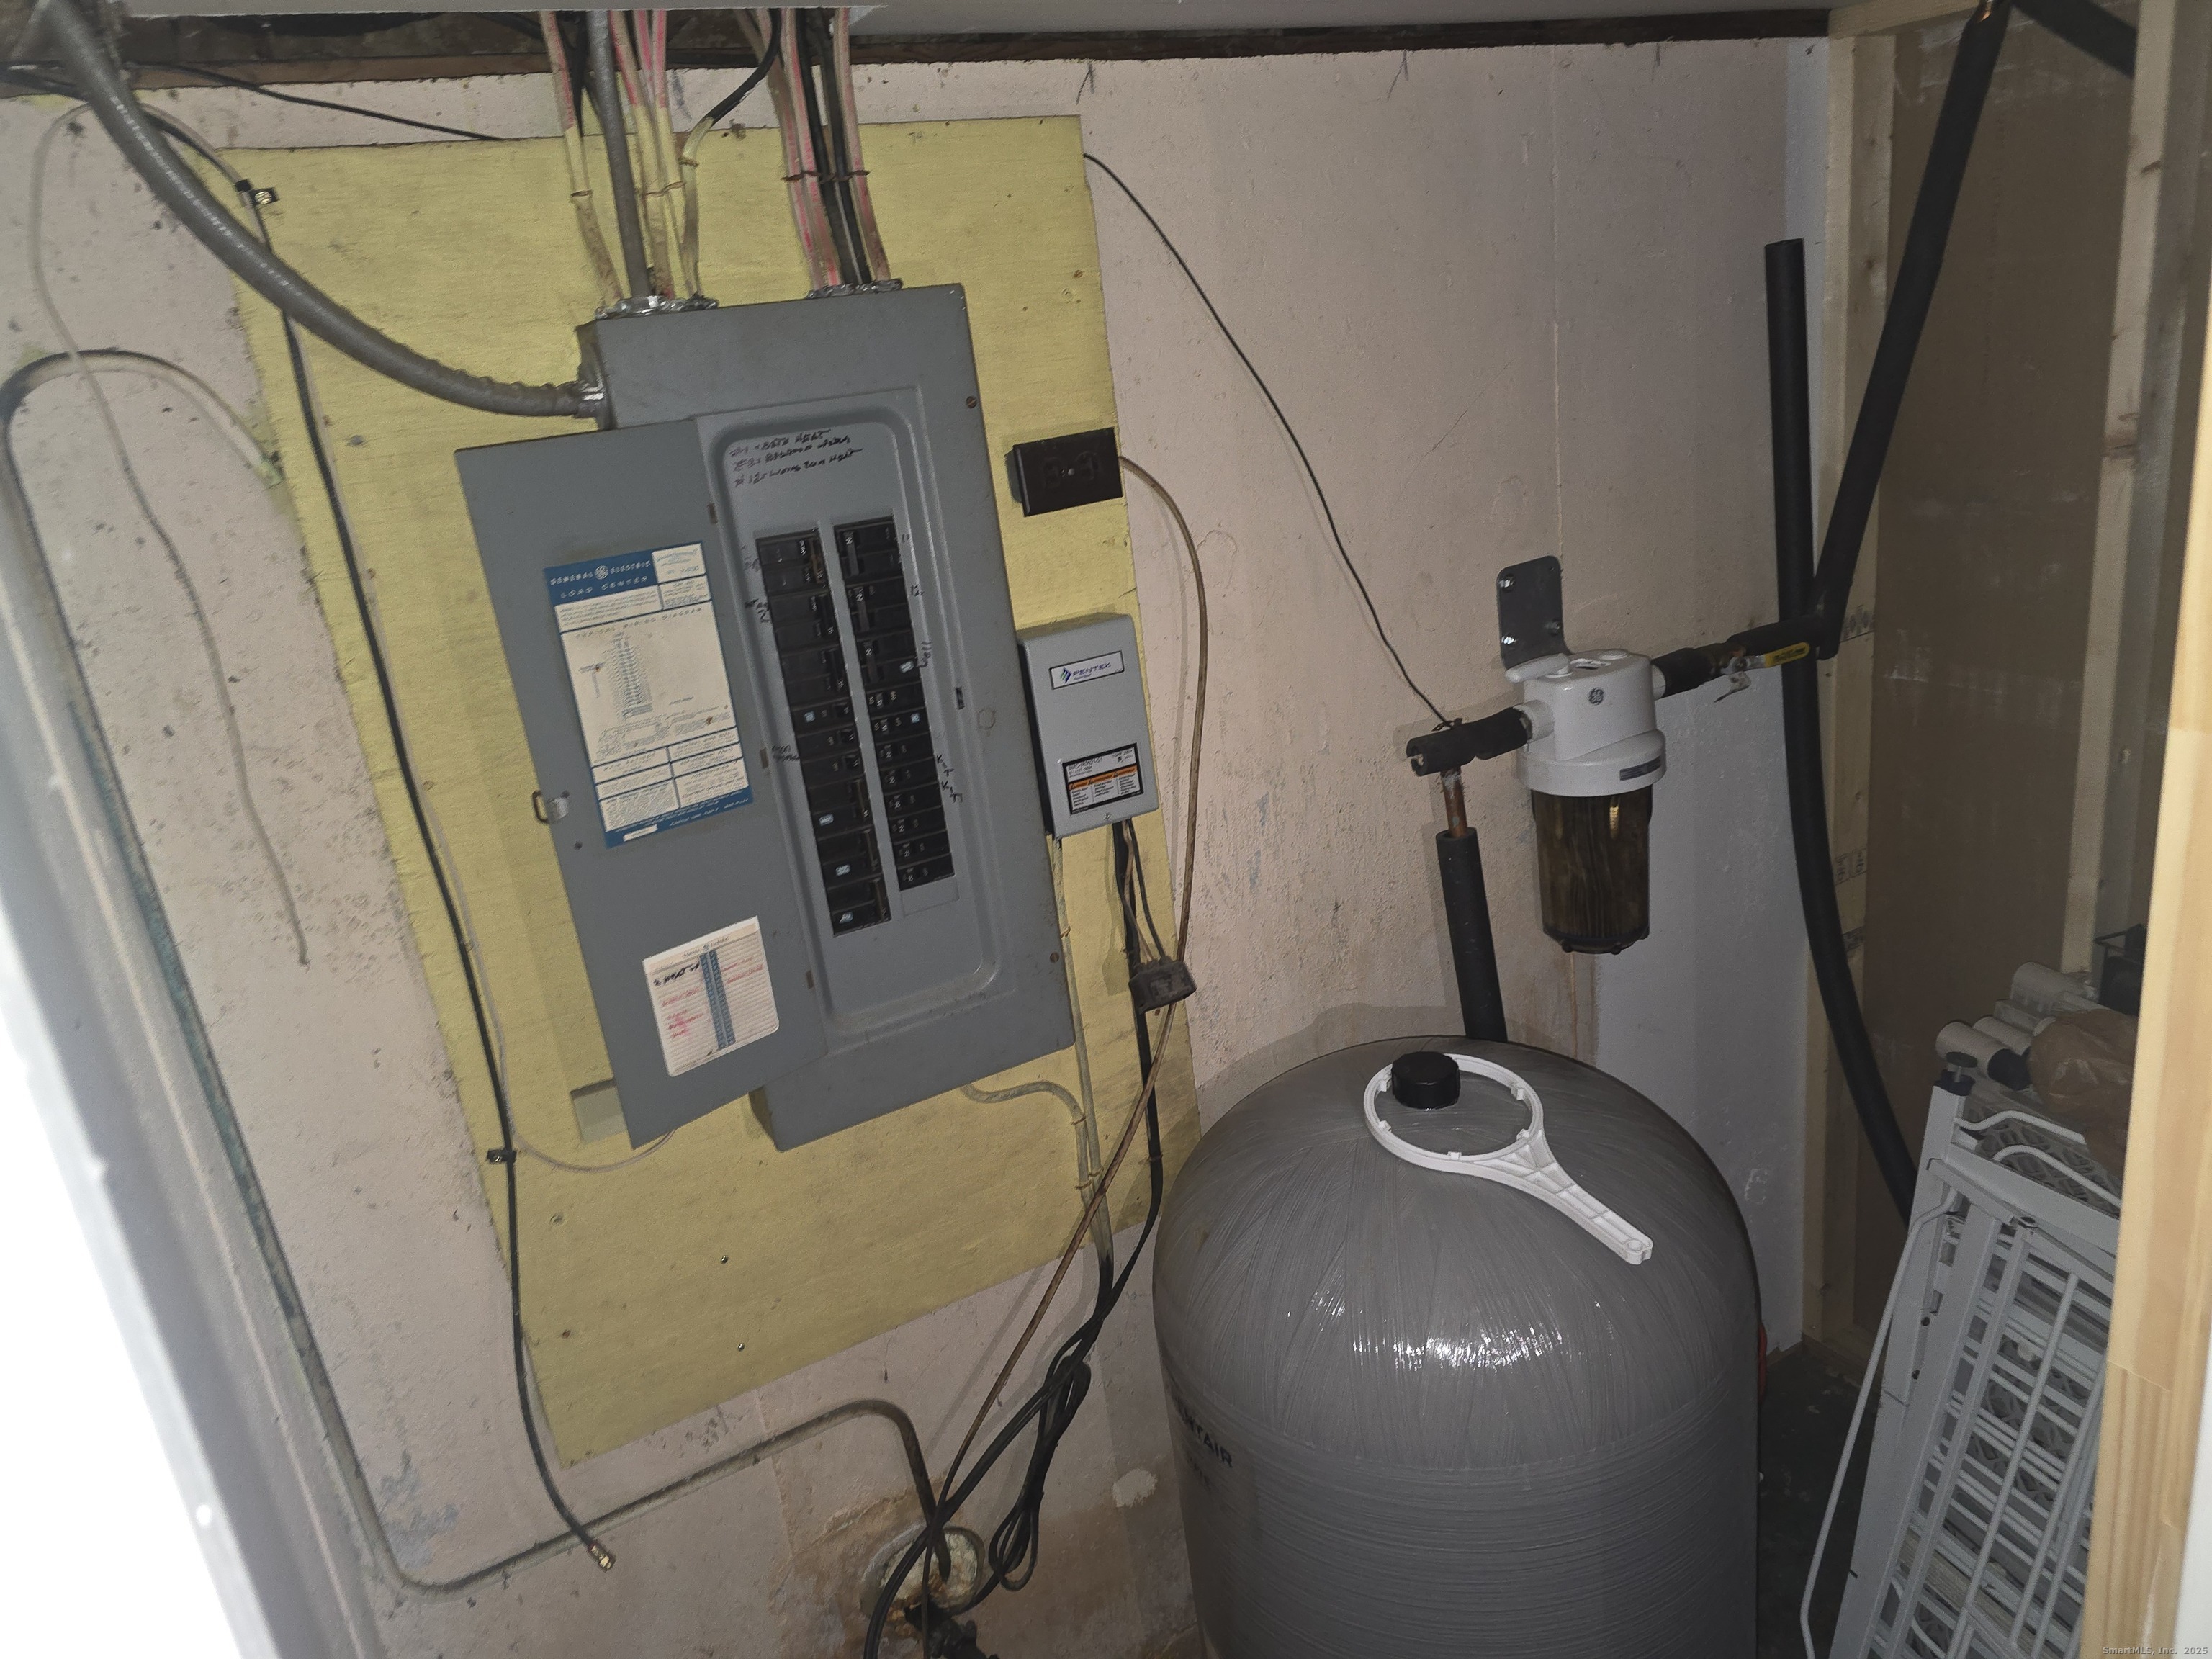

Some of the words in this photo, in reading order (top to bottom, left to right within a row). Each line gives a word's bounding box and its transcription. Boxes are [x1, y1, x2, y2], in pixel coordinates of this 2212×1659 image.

[550, 571, 594, 586] GENERAL
[610, 559, 652, 574] ELECTRIC
[560, 586, 593, 599] LOAD
[601, 575, 648, 591] CENTER
